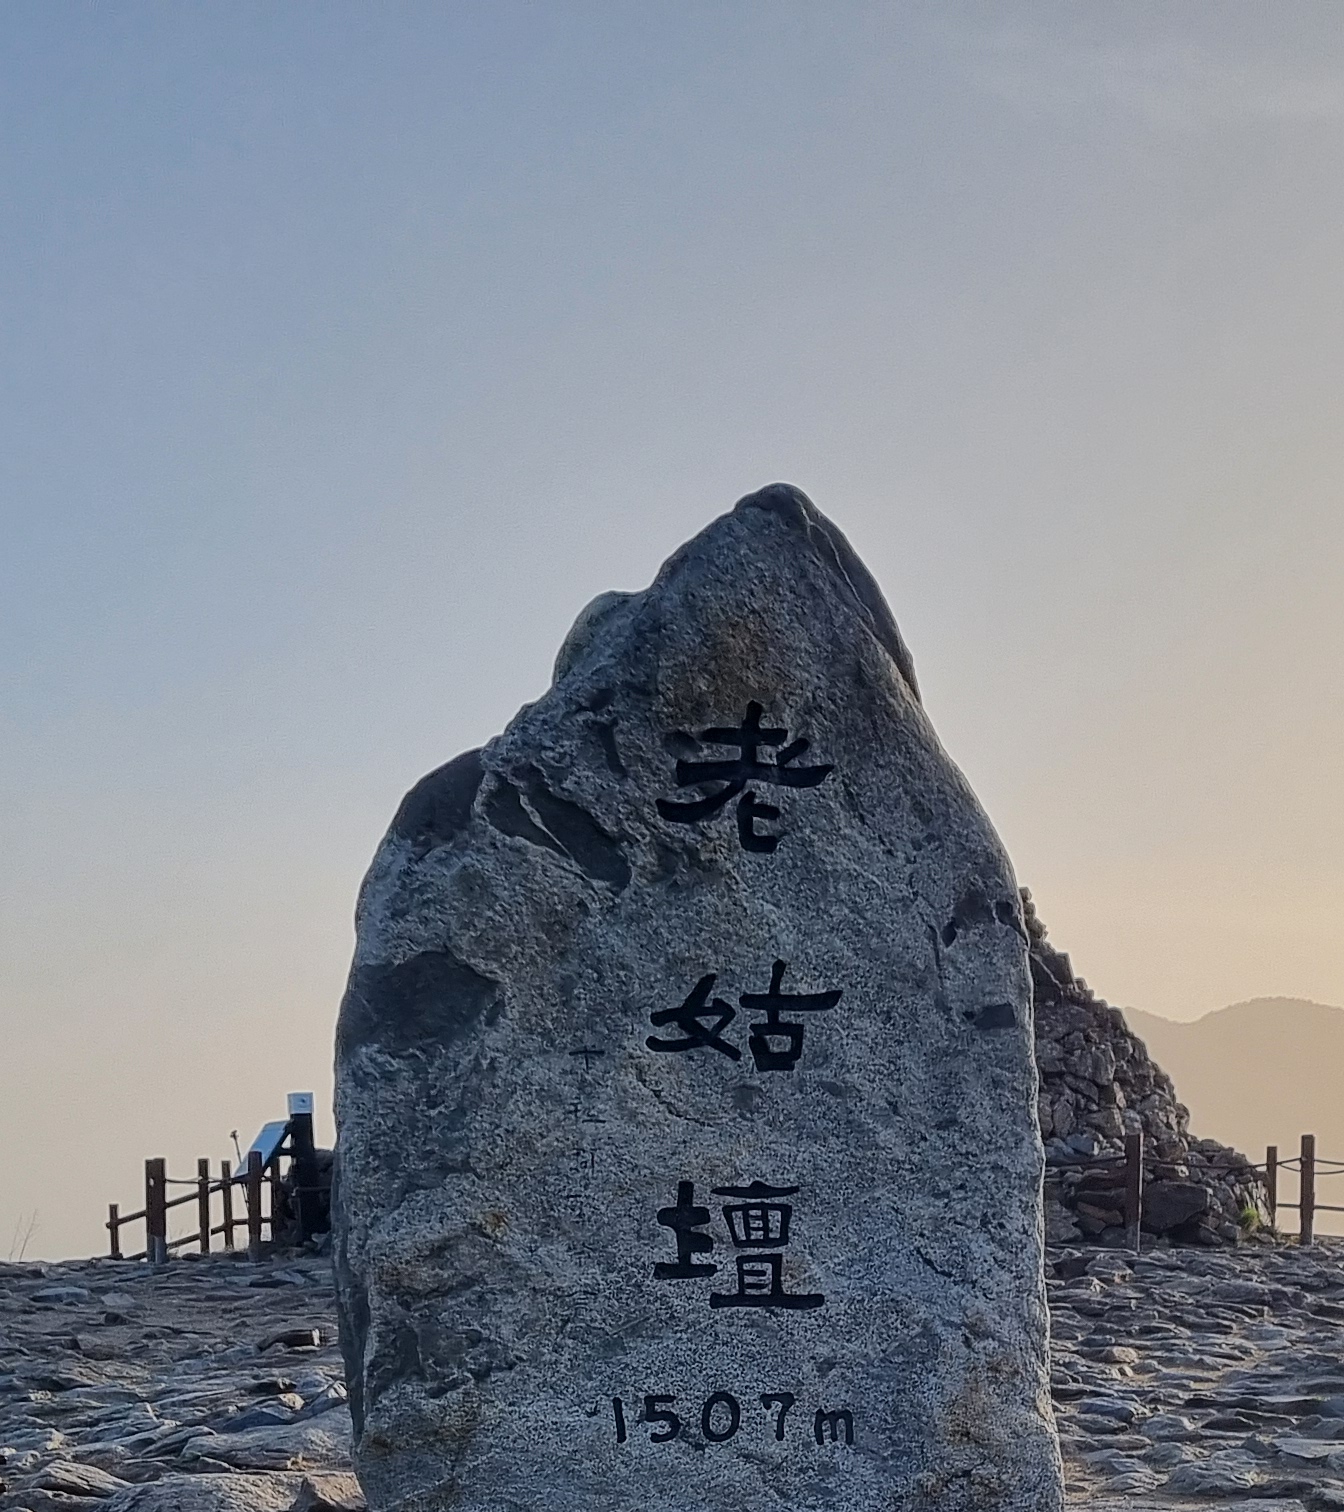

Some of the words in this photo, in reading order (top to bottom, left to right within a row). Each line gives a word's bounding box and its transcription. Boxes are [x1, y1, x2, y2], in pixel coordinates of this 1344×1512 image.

[645, 699, 844, 1309] 老姑壇
[612, 1391, 854, 1446] 1507m
